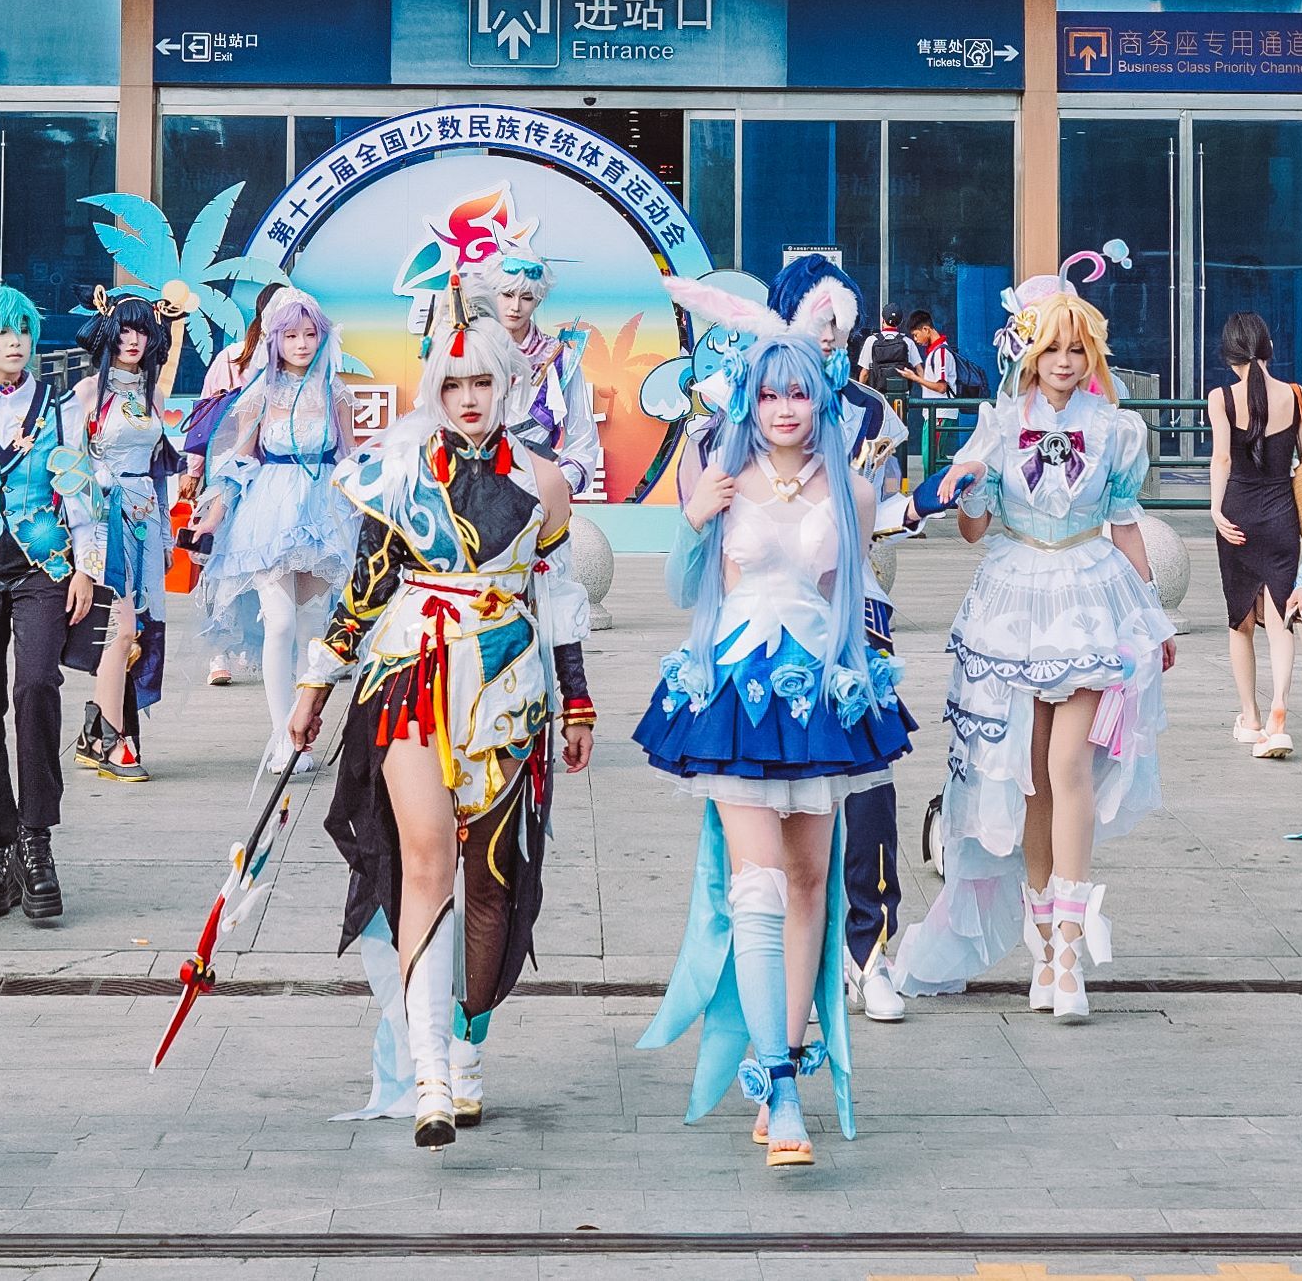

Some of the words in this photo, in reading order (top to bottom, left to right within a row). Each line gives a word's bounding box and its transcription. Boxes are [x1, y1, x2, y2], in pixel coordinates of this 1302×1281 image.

[213, 32, 258, 48] 出站口
[917, 39, 963, 54] 售票处
[214, 51, 233, 62] Exit
[572, 40, 674, 60] Entrance
[926, 57, 961, 68] Tickets
[1118, 60, 1174, 73] Business
[1177, 60, 1211, 73] Class
[1214, 60, 1257, 76] Priority
[267, 115, 688, 250] 第十二届全国少数民族传统体育运动会
